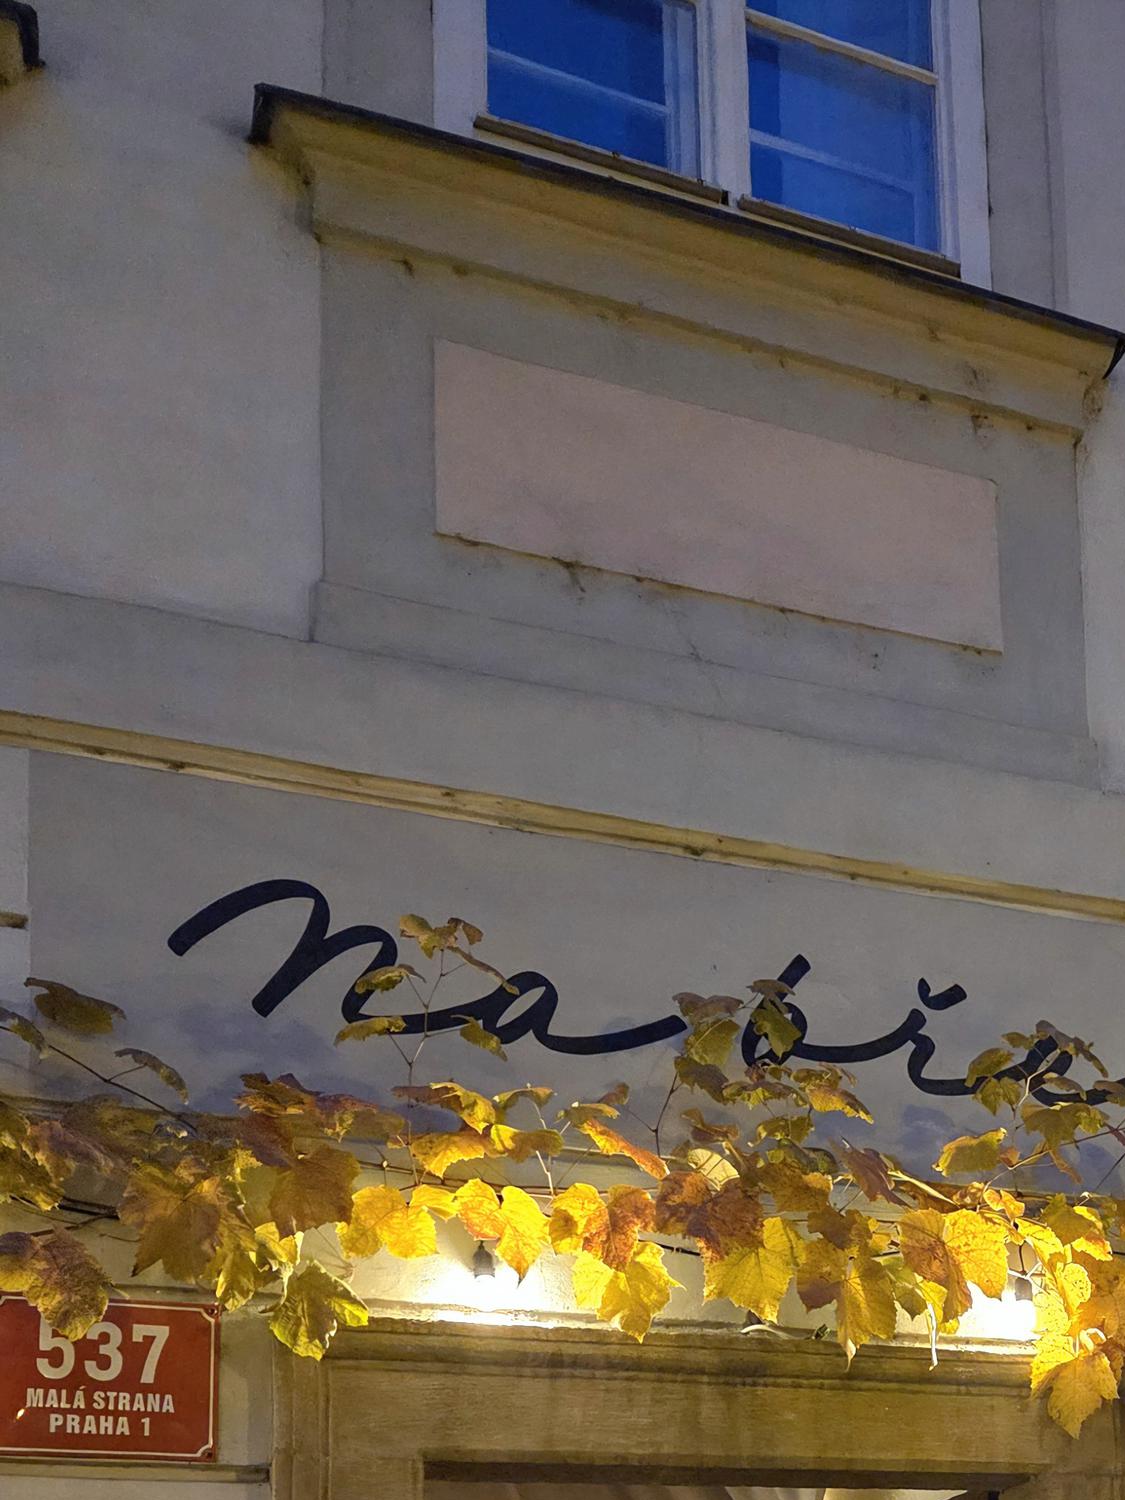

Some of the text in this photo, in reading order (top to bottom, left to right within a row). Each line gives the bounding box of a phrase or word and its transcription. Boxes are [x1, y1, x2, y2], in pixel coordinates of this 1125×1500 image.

[36, 1311, 170, 1384] 537
[26, 1385, 175, 1413] MALÁ STRANA
[49, 1414, 151, 1437] PRAHA 1
